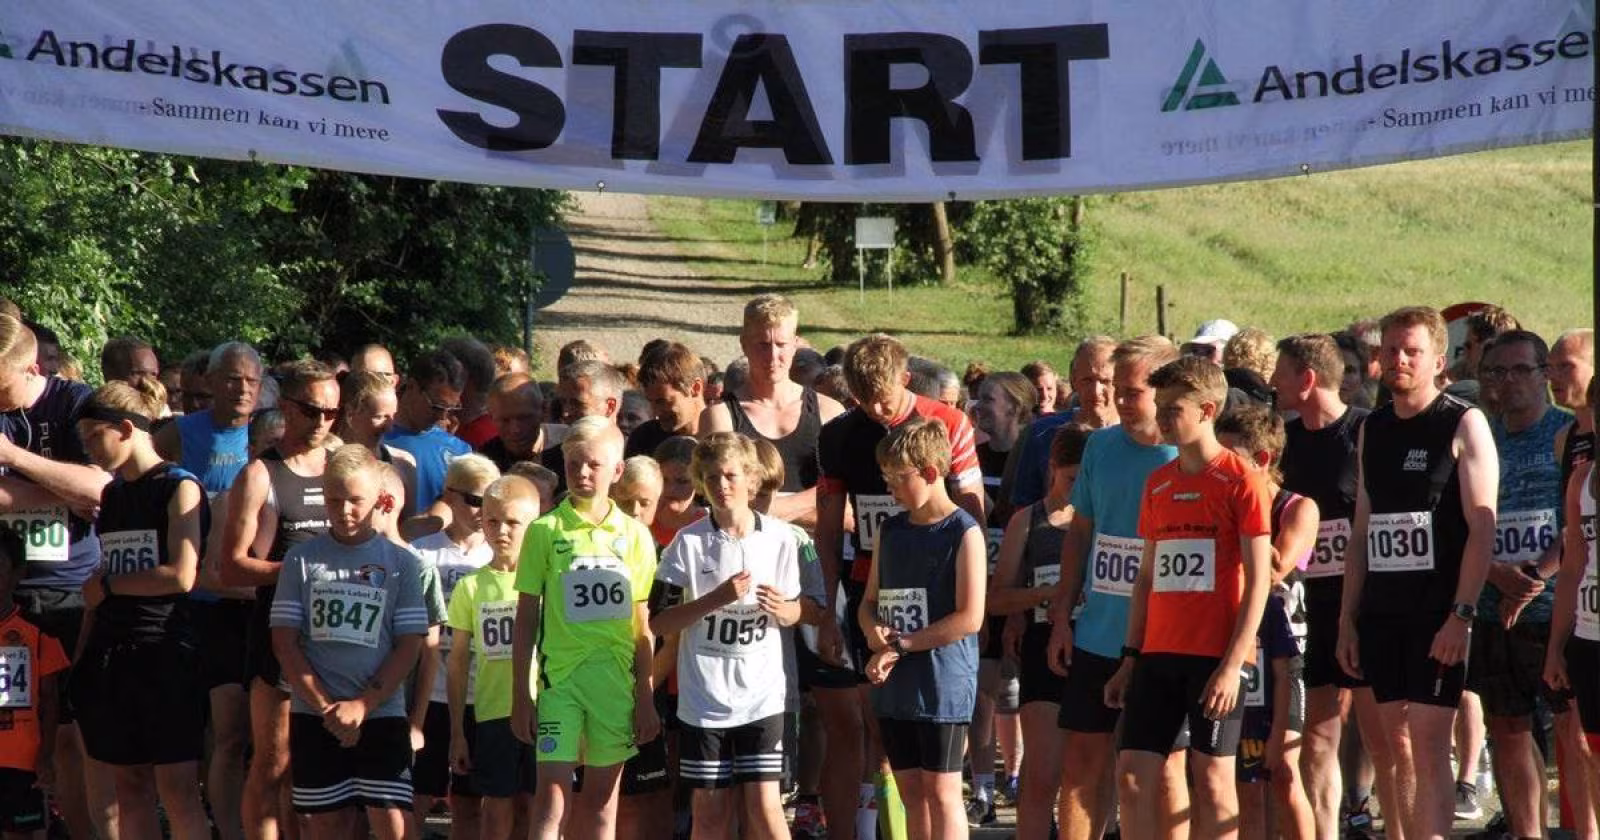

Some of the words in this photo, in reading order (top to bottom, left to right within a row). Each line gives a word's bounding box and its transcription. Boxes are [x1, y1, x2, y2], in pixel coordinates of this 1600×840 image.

[28, 30, 390, 104] Andelskassen
[1253, 31, 1592, 103] Andelskasse
[436, 22, 1110, 165] START
[1382, 101, 1481, 129] Sammen
[1490, 94, 1530, 113] kan
[1537, 85, 1557, 105] vi
[152, 97, 249, 125] Sammen
[258, 110, 299, 131] kan
[308, 120, 327, 136] vi
[334, 123, 390, 142] mere
[0, 519, 65, 548] 860
[1369, 528, 1429, 559] 1030
[1095, 551, 1140, 584] 606
[1159, 553, 1205, 577] 302
[572, 581, 625, 608] 306
[311, 598, 381, 633] 3847
[703, 614, 769, 646] 1053
